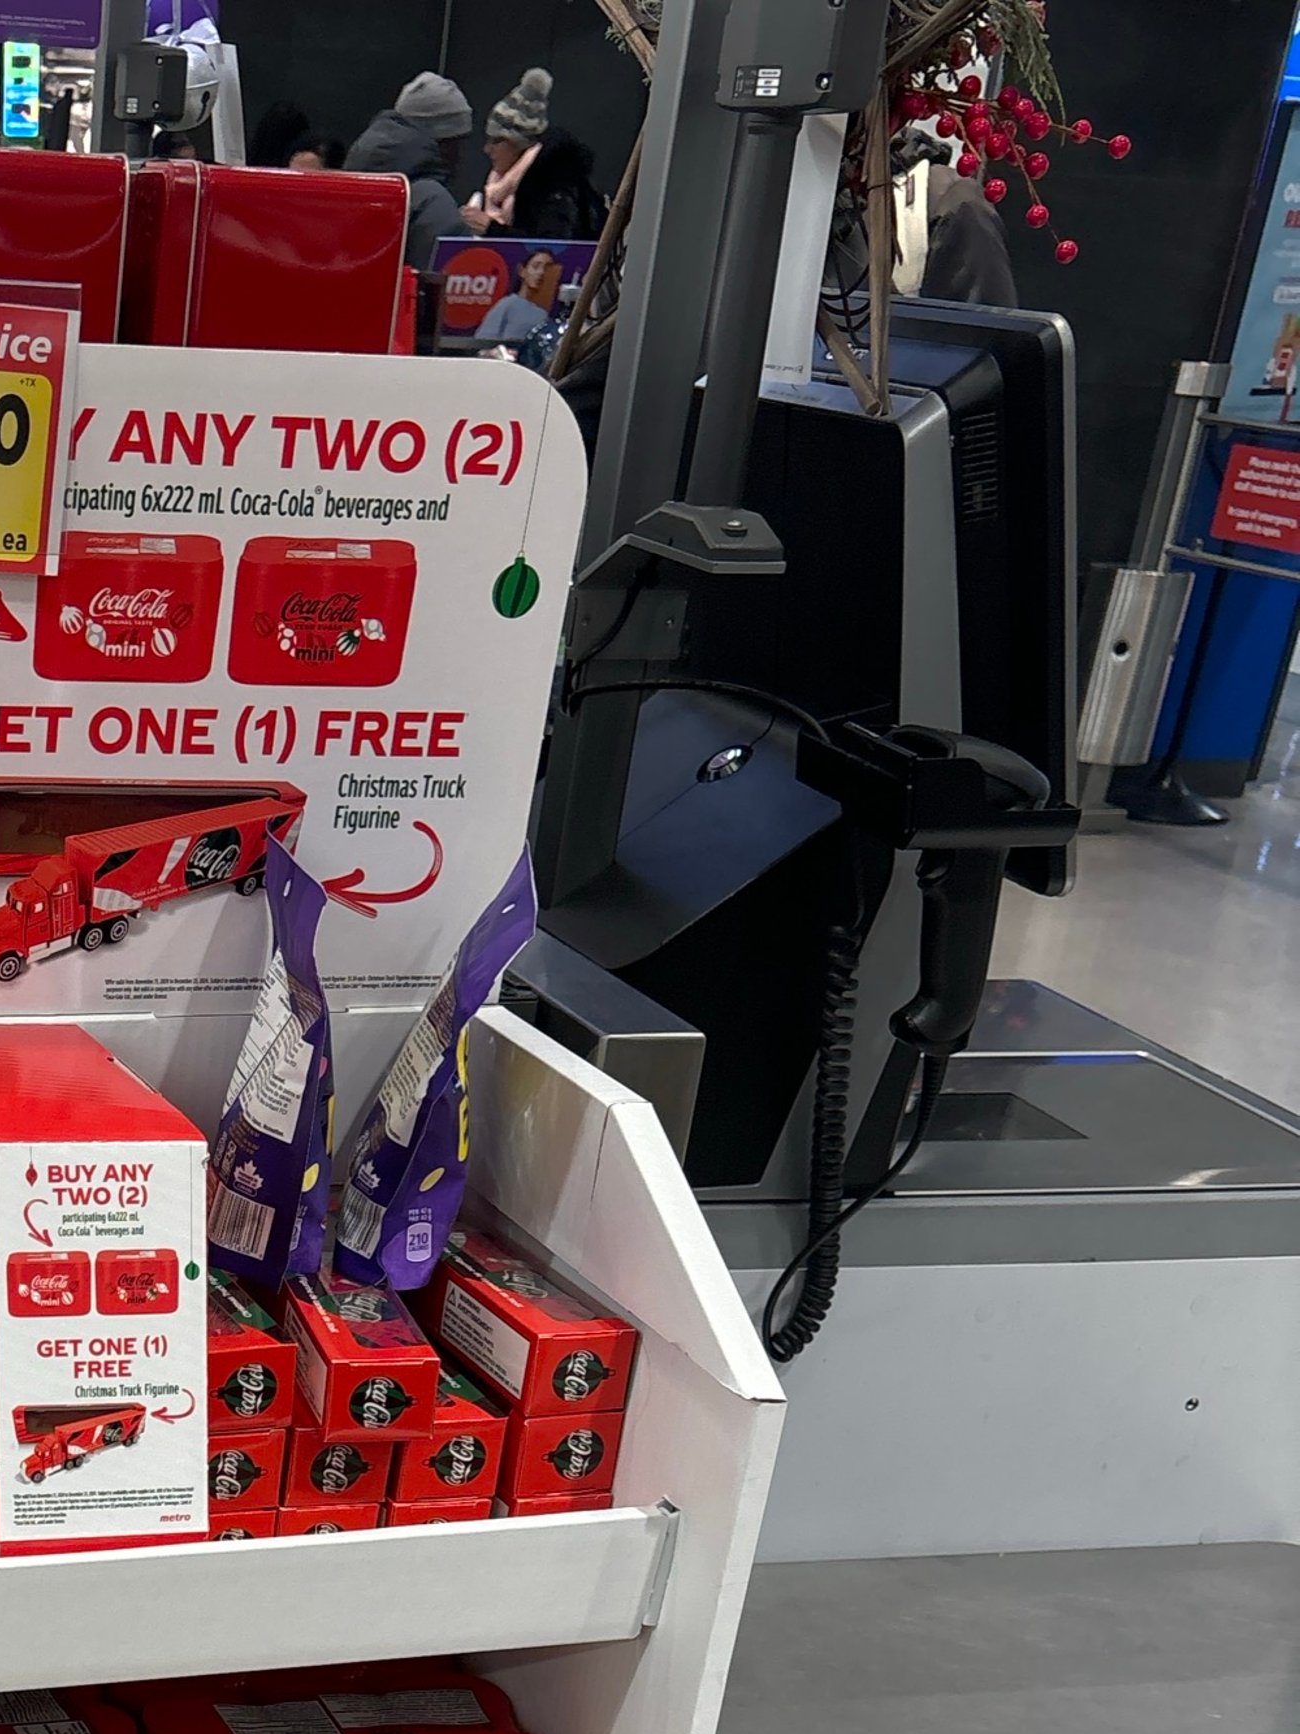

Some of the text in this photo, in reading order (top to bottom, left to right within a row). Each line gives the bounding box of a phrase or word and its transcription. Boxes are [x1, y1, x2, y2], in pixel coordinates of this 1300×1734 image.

[108, 409, 256, 467] ANY
[271, 416, 426, 474] TWO
[445, 418, 523, 486] (2)
[141, 484, 193, 514] 6x222
[198, 486, 225, 516] mL
[323, 490, 412, 526] beverages
[416, 494, 450, 522] and
[2, 532, 29, 553] ea
[89, 587, 176, 619] Coca-Cola
[281, 592, 364, 623] Coca-Cola
[105, 640, 146, 658] mini
[294, 644, 336, 662] mini
[88, 708, 219, 756] ONE
[234, 704, 297, 765] (1)
[314, 710, 469, 759] FREE
[337, 773, 467, 802] Christmas Truck
[333, 804, 400, 834] Figurine
[47, 1163, 154, 1184] BUY ANY
[52, 1185, 149, 1208] TWO (2)
[62, 1211, 107, 1224] participating
[94, 1225, 129, 1238] beverages
[130, 1224, 145, 1236] and
[409, 1232, 430, 1246] 210
[37, 1335, 169, 1358] GET ONE (1)
[73, 1359, 133, 1379] FREE
[74, 1382, 180, 1399] Christmas Truck Figurine
[160, 1513, 191, 1523] metro
